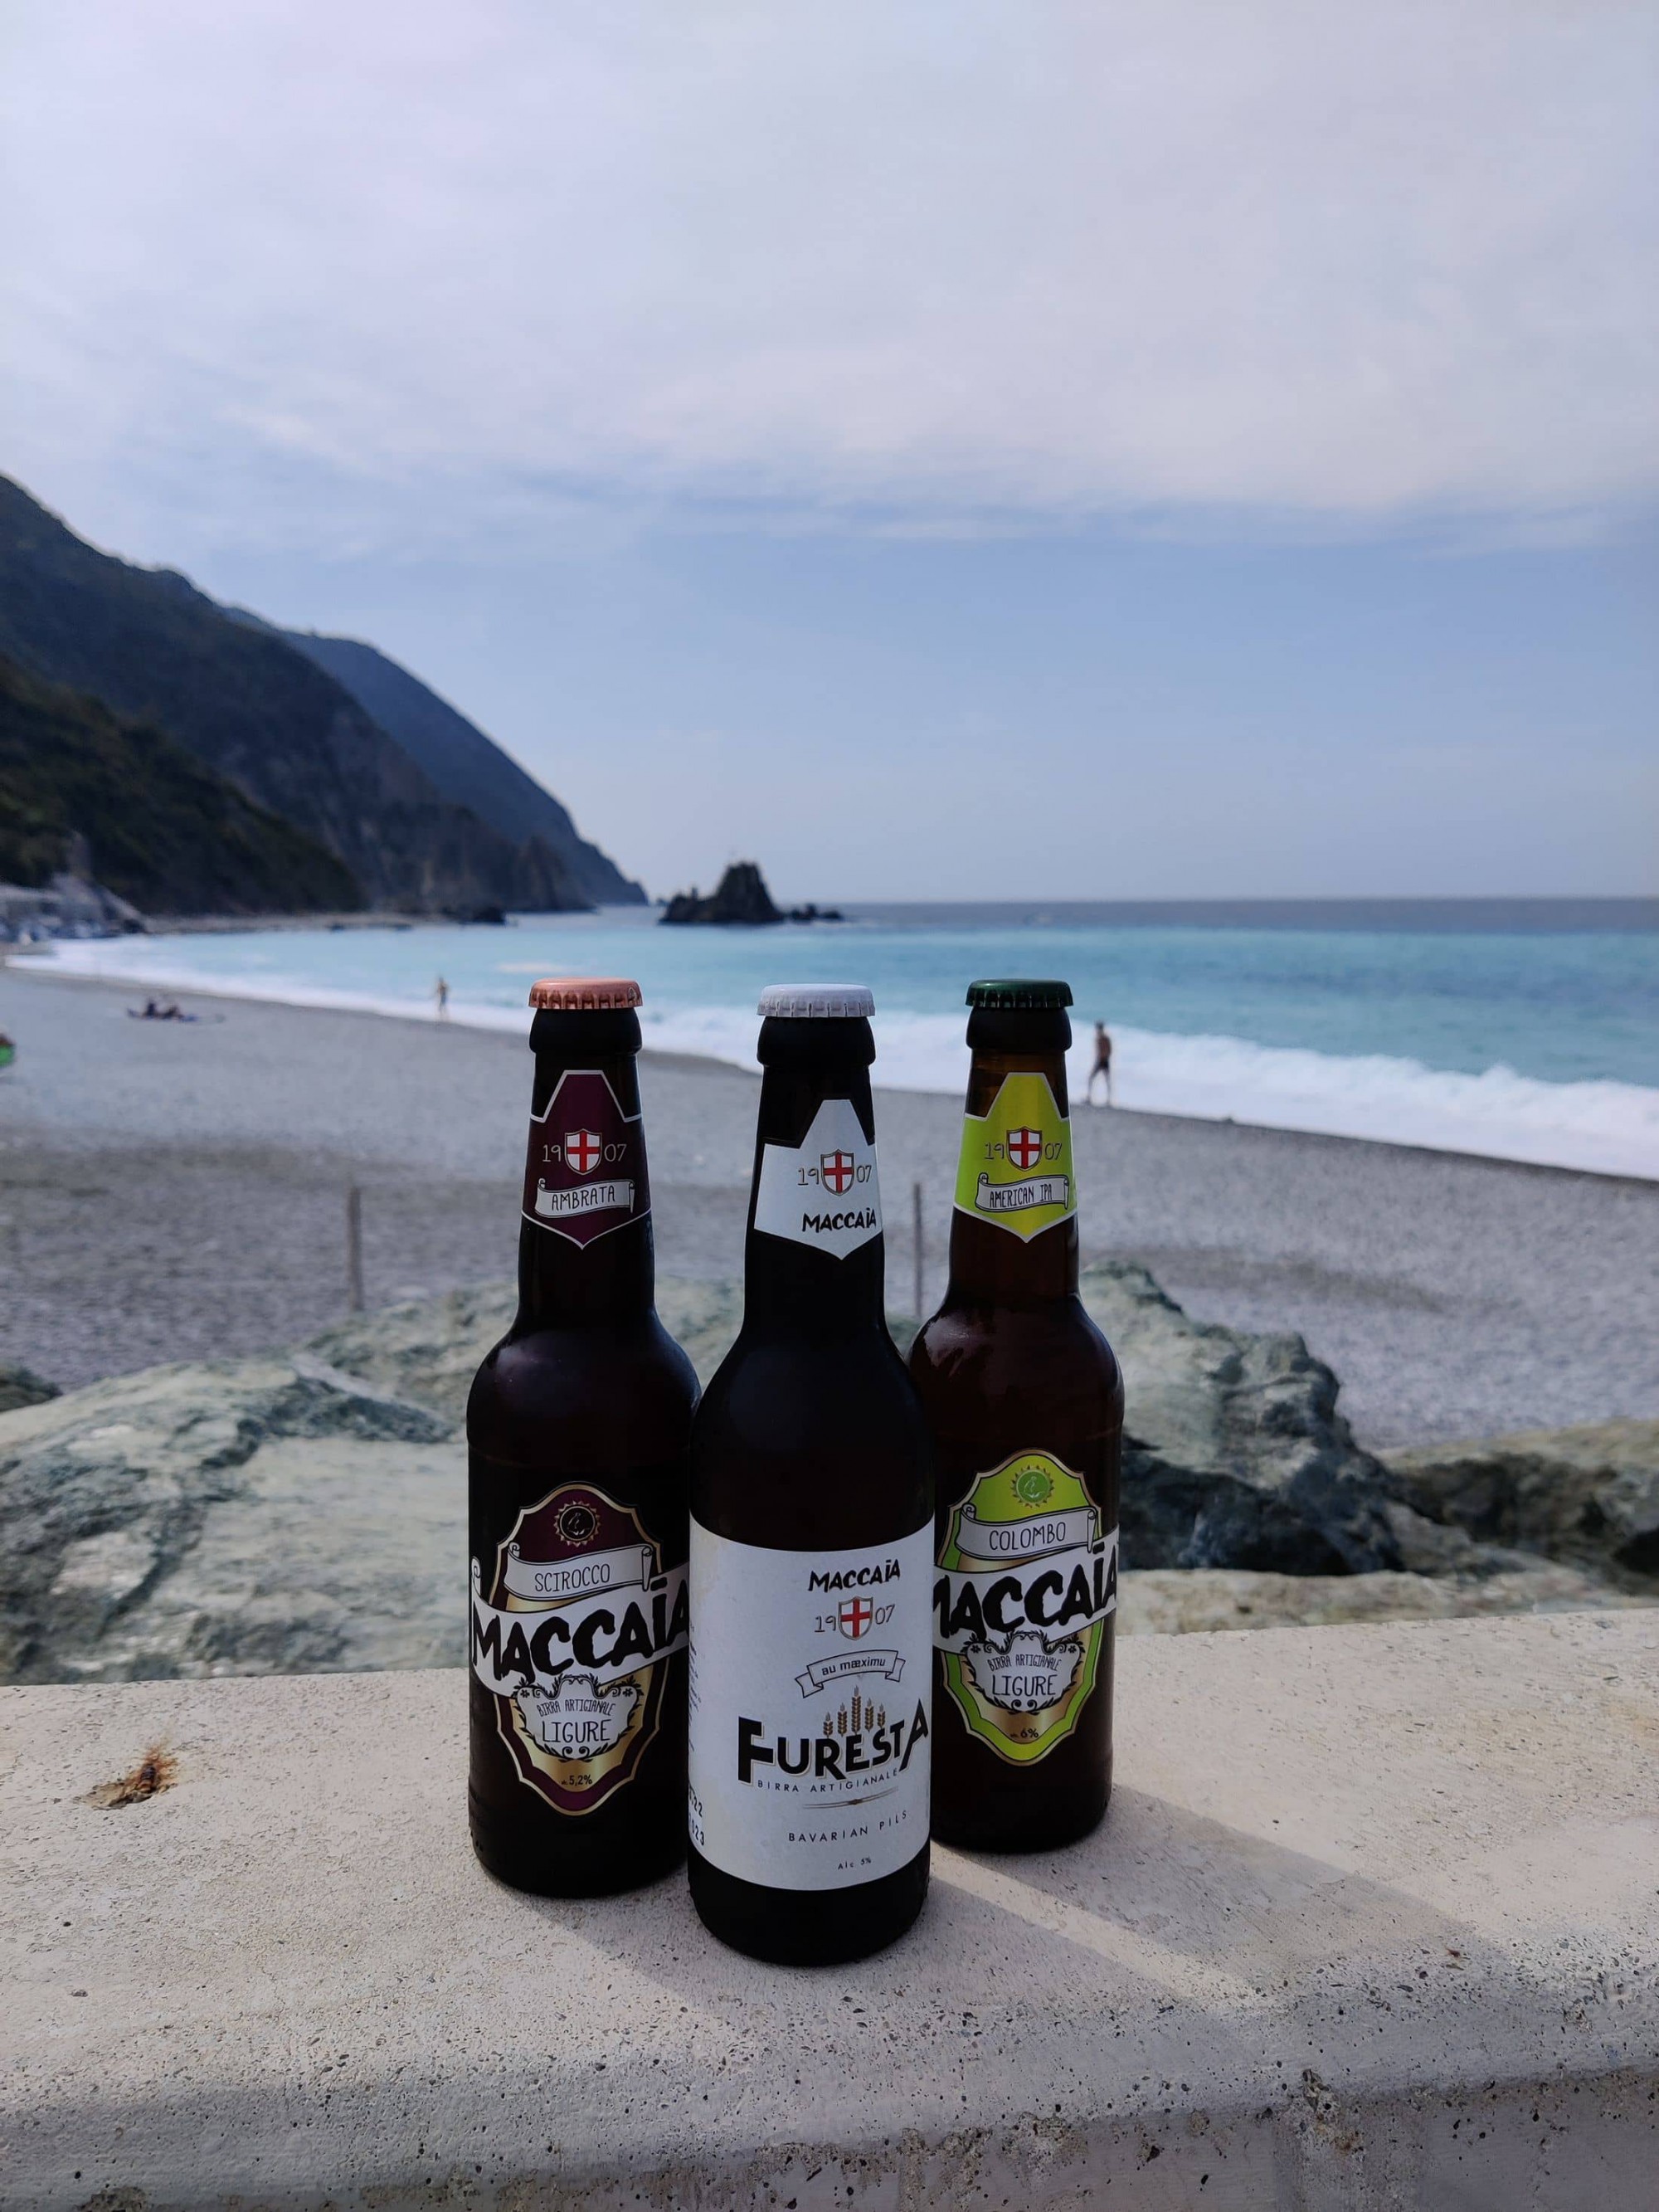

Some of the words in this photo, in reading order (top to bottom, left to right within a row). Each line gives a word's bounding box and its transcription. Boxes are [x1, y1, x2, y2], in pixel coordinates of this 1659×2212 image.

[552, 1185, 615, 1211] AMBRATA
[990, 1186, 1034, 1208] AMERICAN
[1040, 1183, 1053, 1201] IPA
[990, 1522, 1067, 1552] COLOMBO
[535, 1563, 611, 1592] SCIROCCO
[821, 1665, 836, 1675] au
[987, 1655, 1012, 1671] BIRRA
[1015, 1654, 1063, 1672] ARTIGIANALE
[992, 1674, 1058, 1697] LIGURE
[537, 1700, 561, 1717] BIRRA
[565, 1698, 615, 1717] ARTIGIANALE
[542, 1718, 612, 1743] LIGURE
[737, 1698, 929, 1784] FURESTA
[569, 1774, 593, 1786] 5,2%
[757, 1780, 800, 1792] BIRRA
[810, 1767, 898, 1793] ARTIGIANALE
[789, 1826, 868, 1843] BAVARIAN
[879, 1810, 907, 1830] PILS
